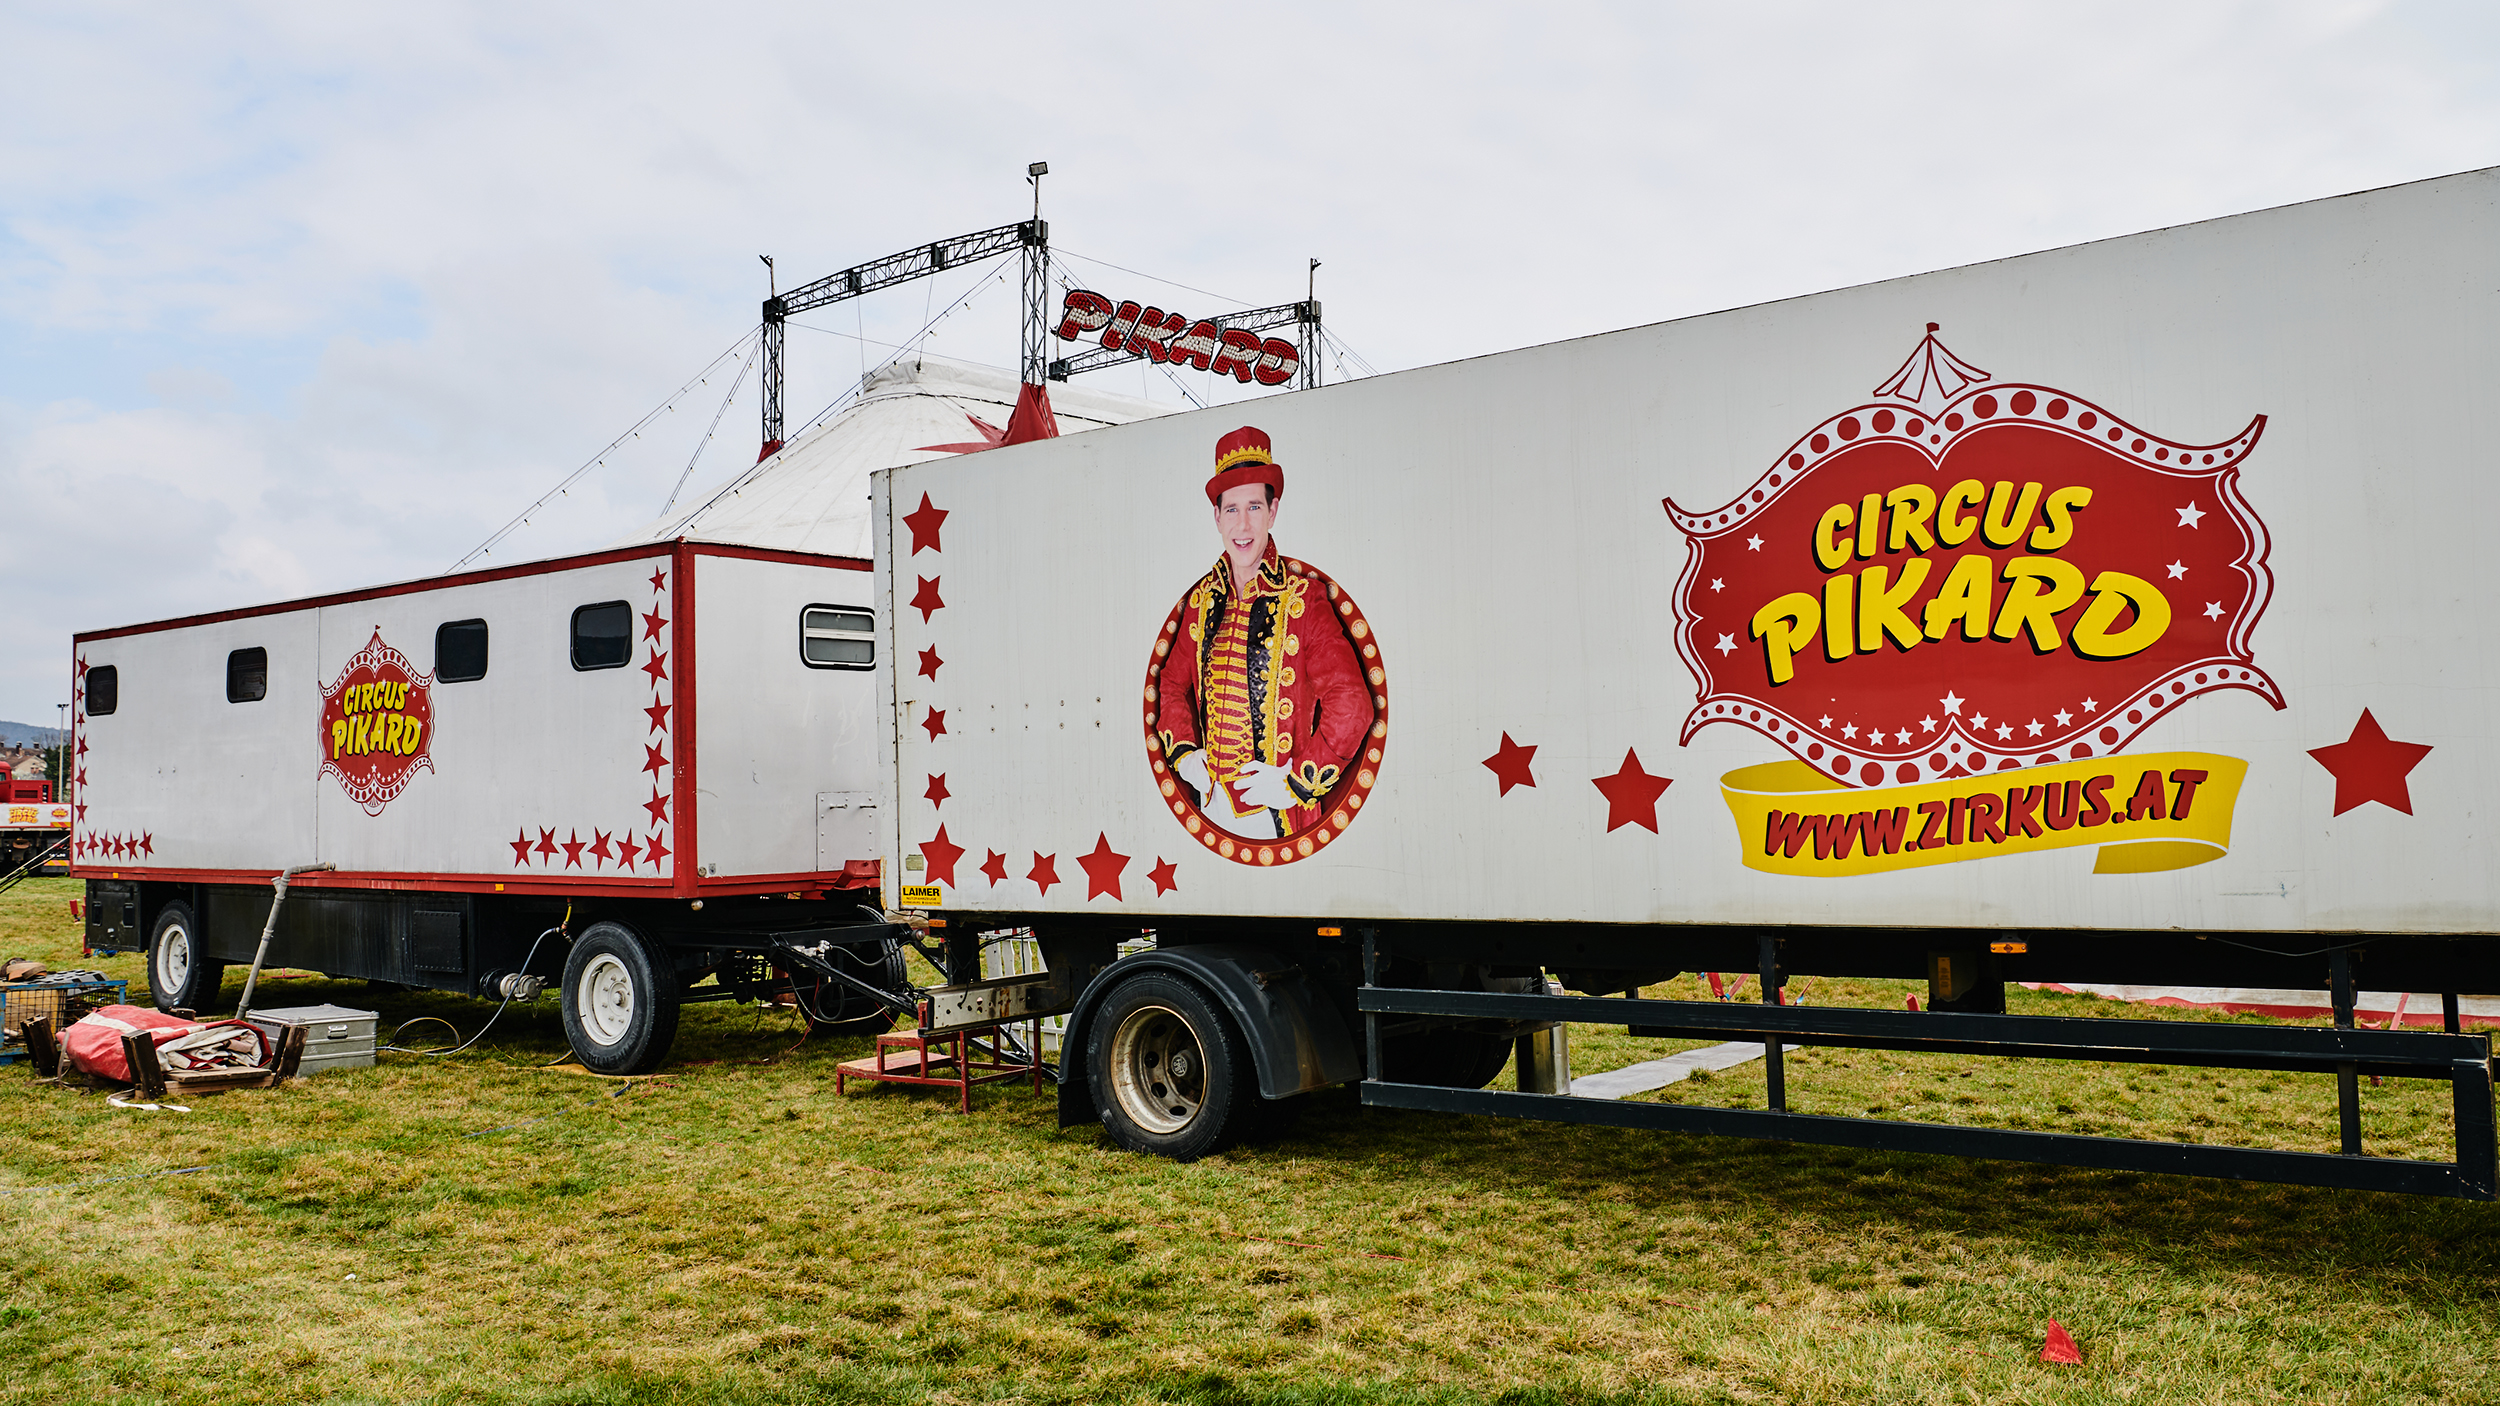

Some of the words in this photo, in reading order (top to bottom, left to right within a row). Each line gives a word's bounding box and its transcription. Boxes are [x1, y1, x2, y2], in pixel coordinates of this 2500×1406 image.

[1057, 289, 1299, 385] PIKARD
[1813, 479, 2093, 573] CIRCUS
[1749, 554, 2171, 687] PIKARD
[331, 712, 421, 761] PIKARD
[343, 680, 410, 716] CIRCUS
[1765, 769, 2208, 860] WWW.ZIRKUS.AT
[903, 887, 940, 896] LAIMER
